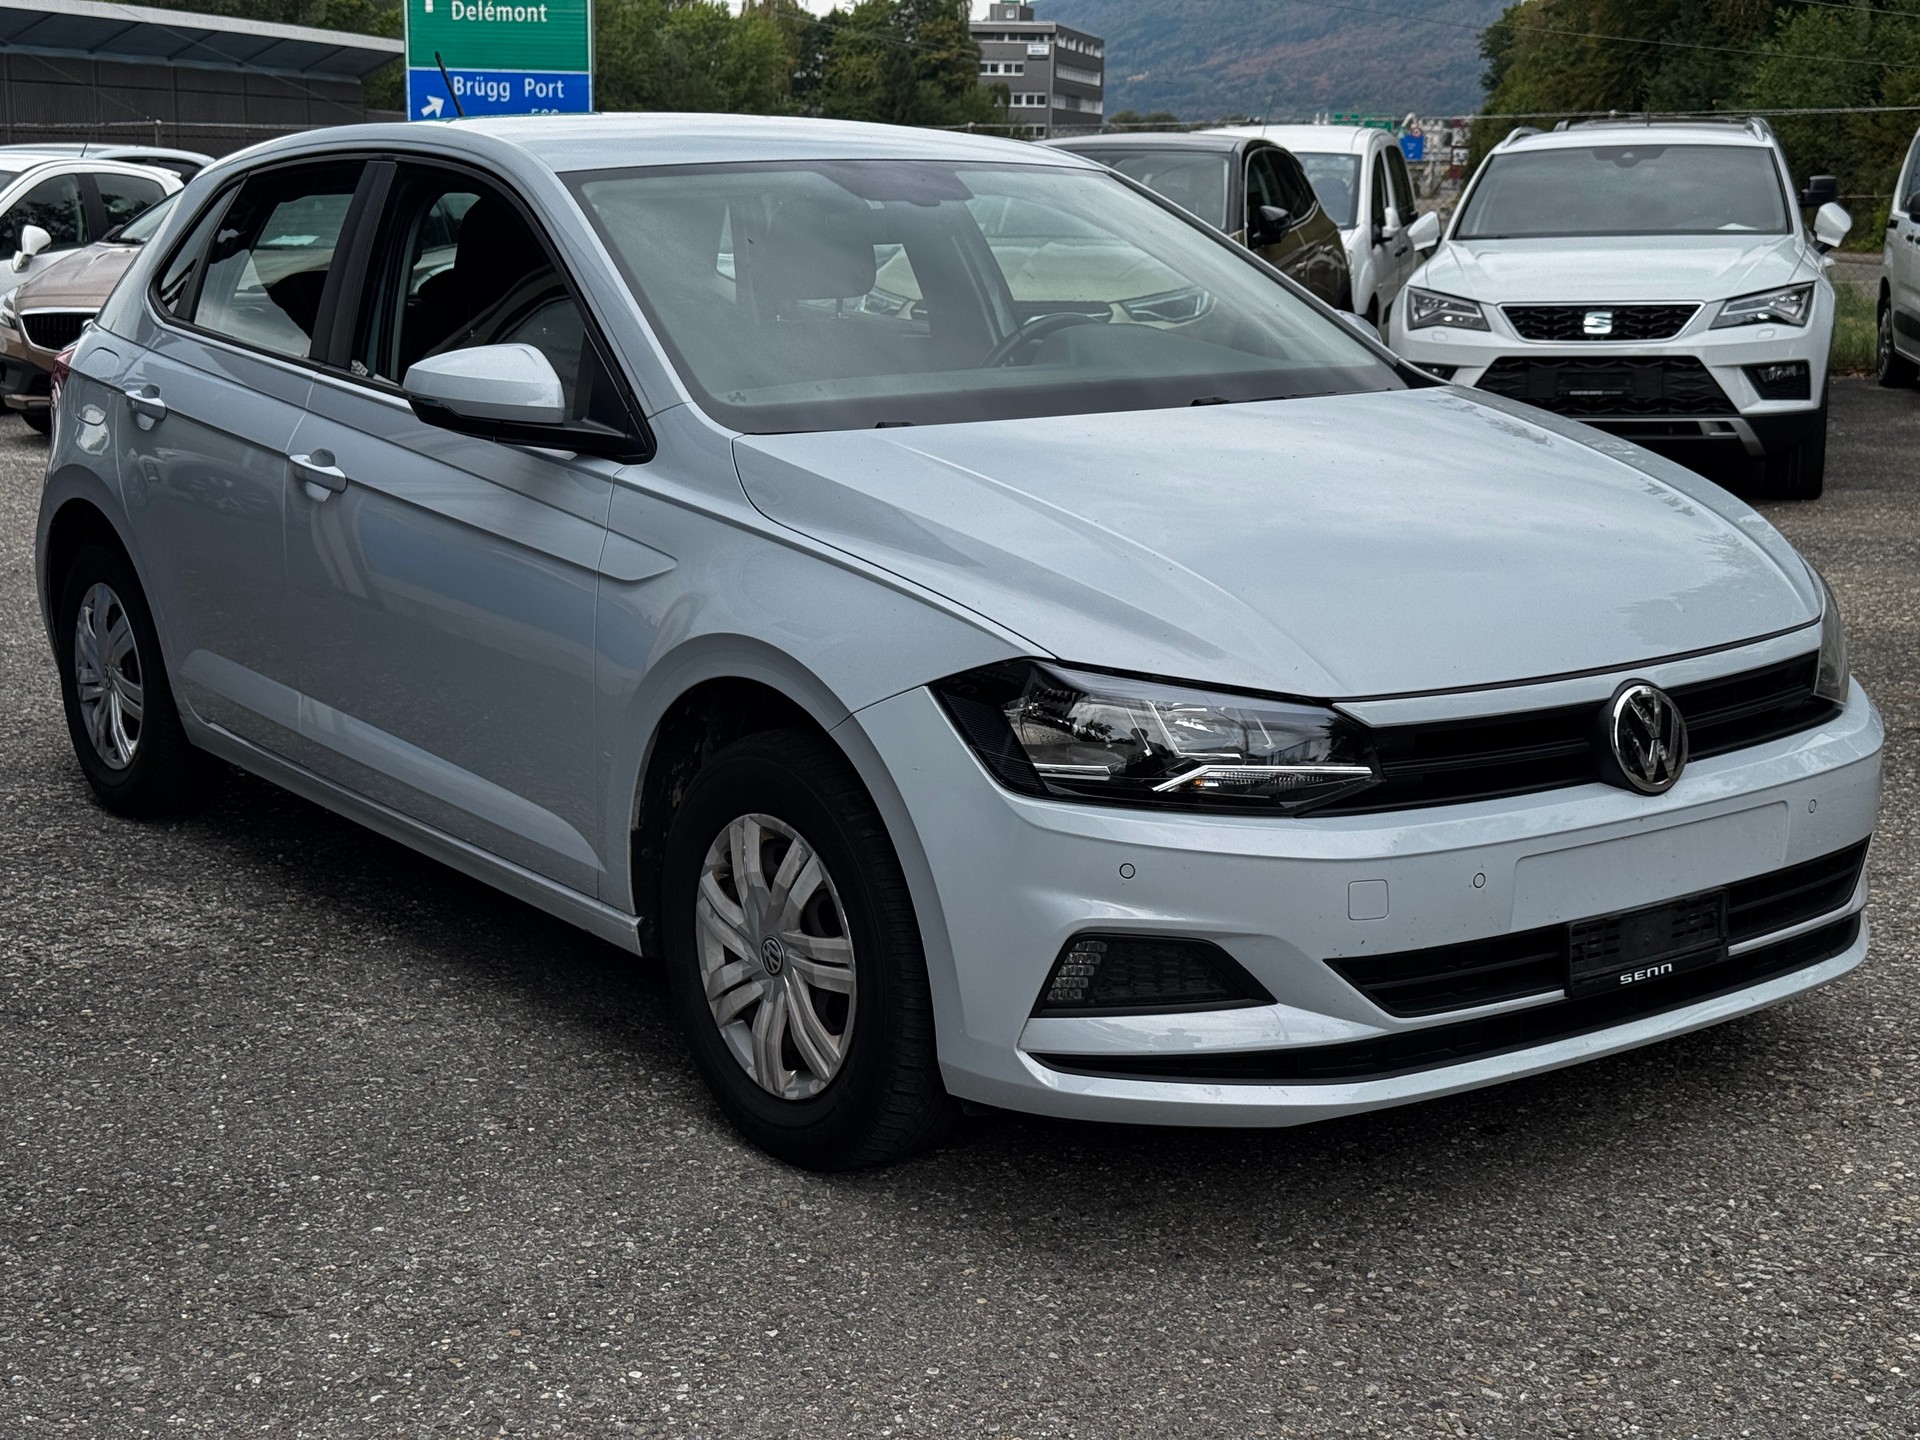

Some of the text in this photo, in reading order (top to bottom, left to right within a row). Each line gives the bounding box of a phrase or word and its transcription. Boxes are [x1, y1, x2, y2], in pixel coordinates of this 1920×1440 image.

[451, 1, 547, 22] Delémont
[453, 76, 565, 102] Brügg Port
